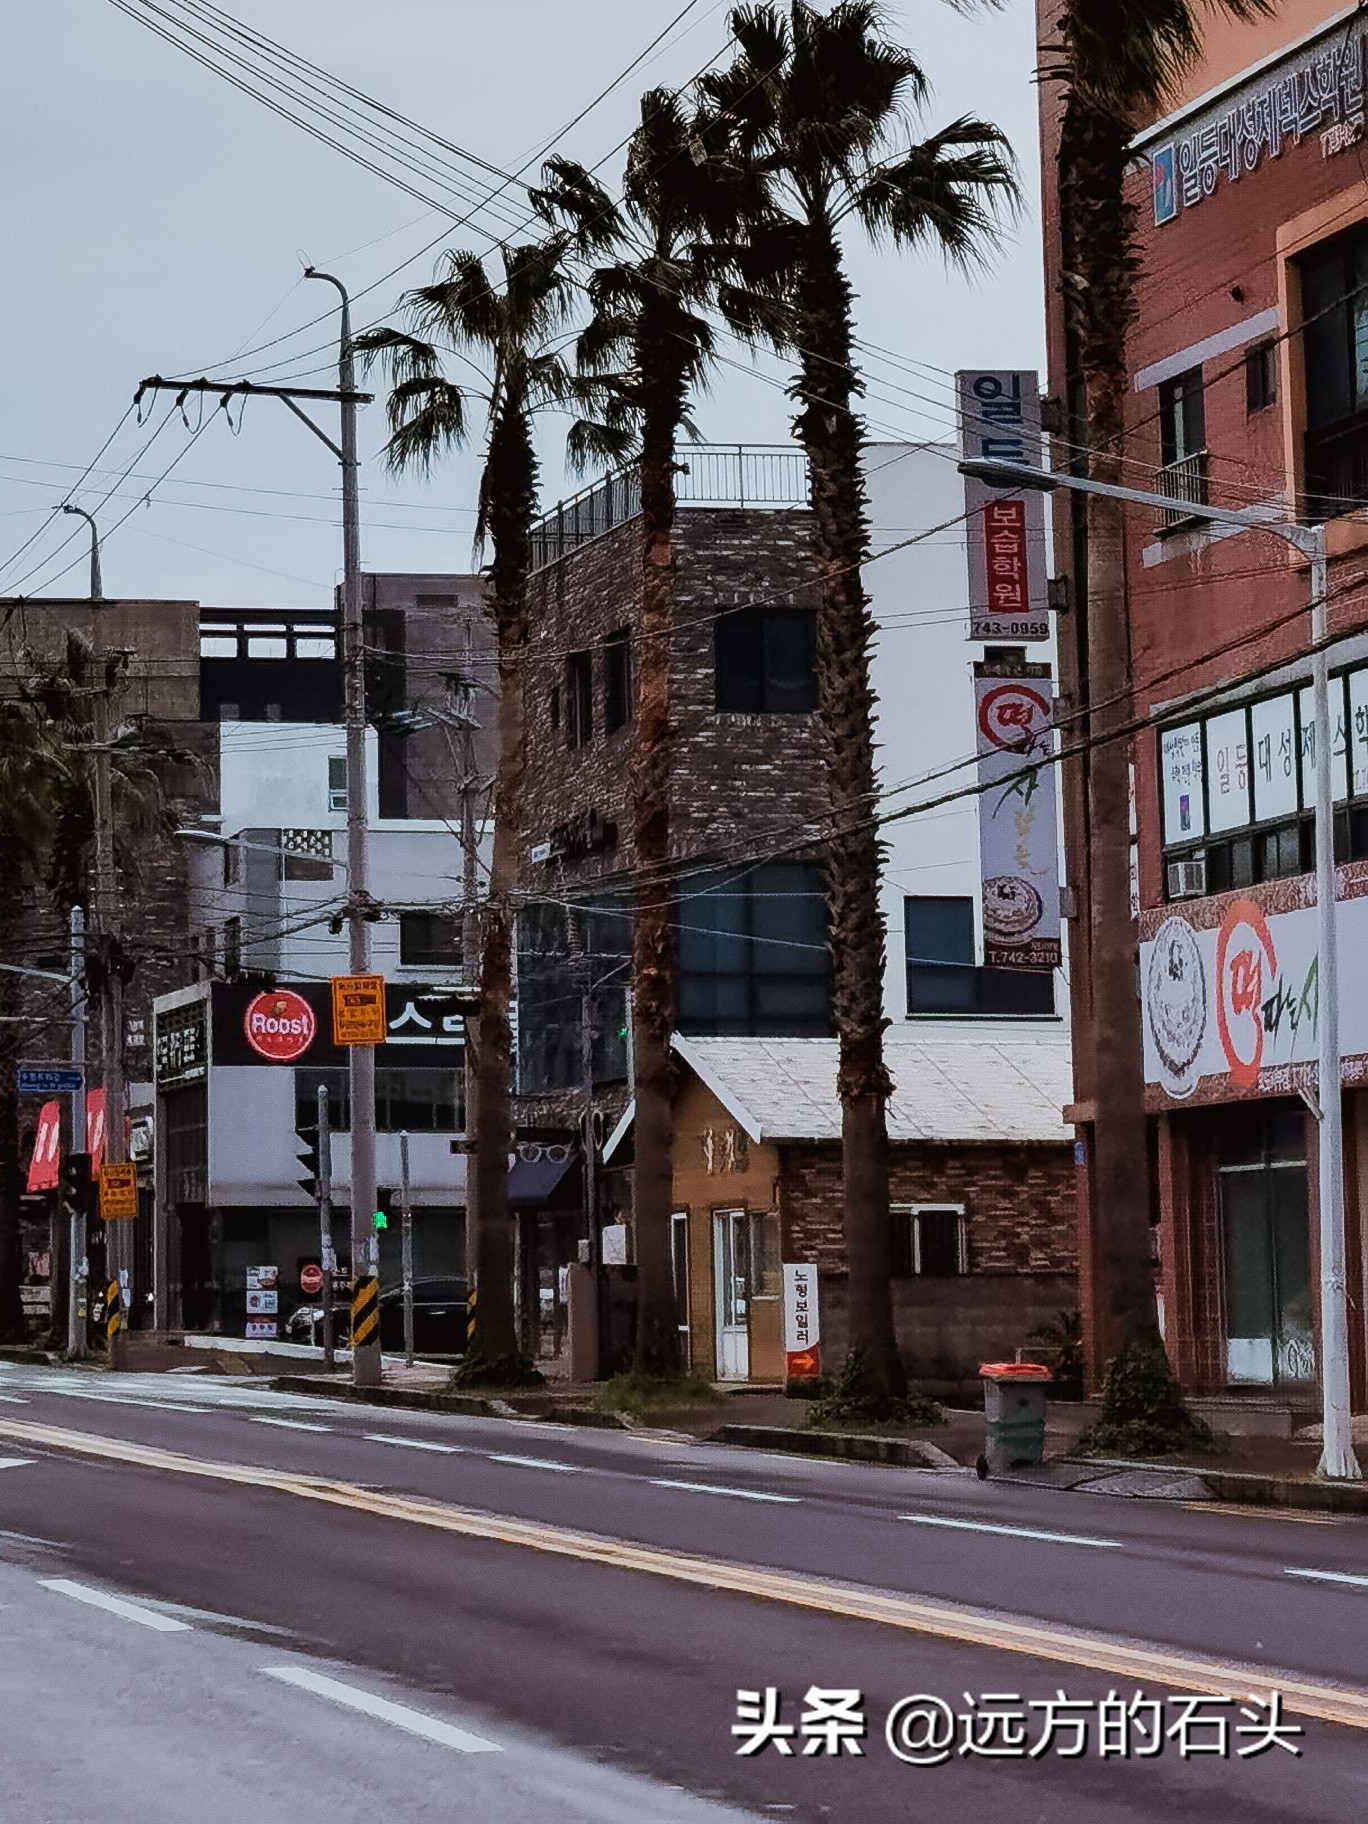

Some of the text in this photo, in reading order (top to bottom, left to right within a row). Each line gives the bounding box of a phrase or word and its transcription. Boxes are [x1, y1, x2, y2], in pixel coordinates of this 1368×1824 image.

[989, 506, 1023, 608] 보습학원
[973, 622, 1048, 634] 743-0959
[794, 1269, 809, 1346] 노형보일러
